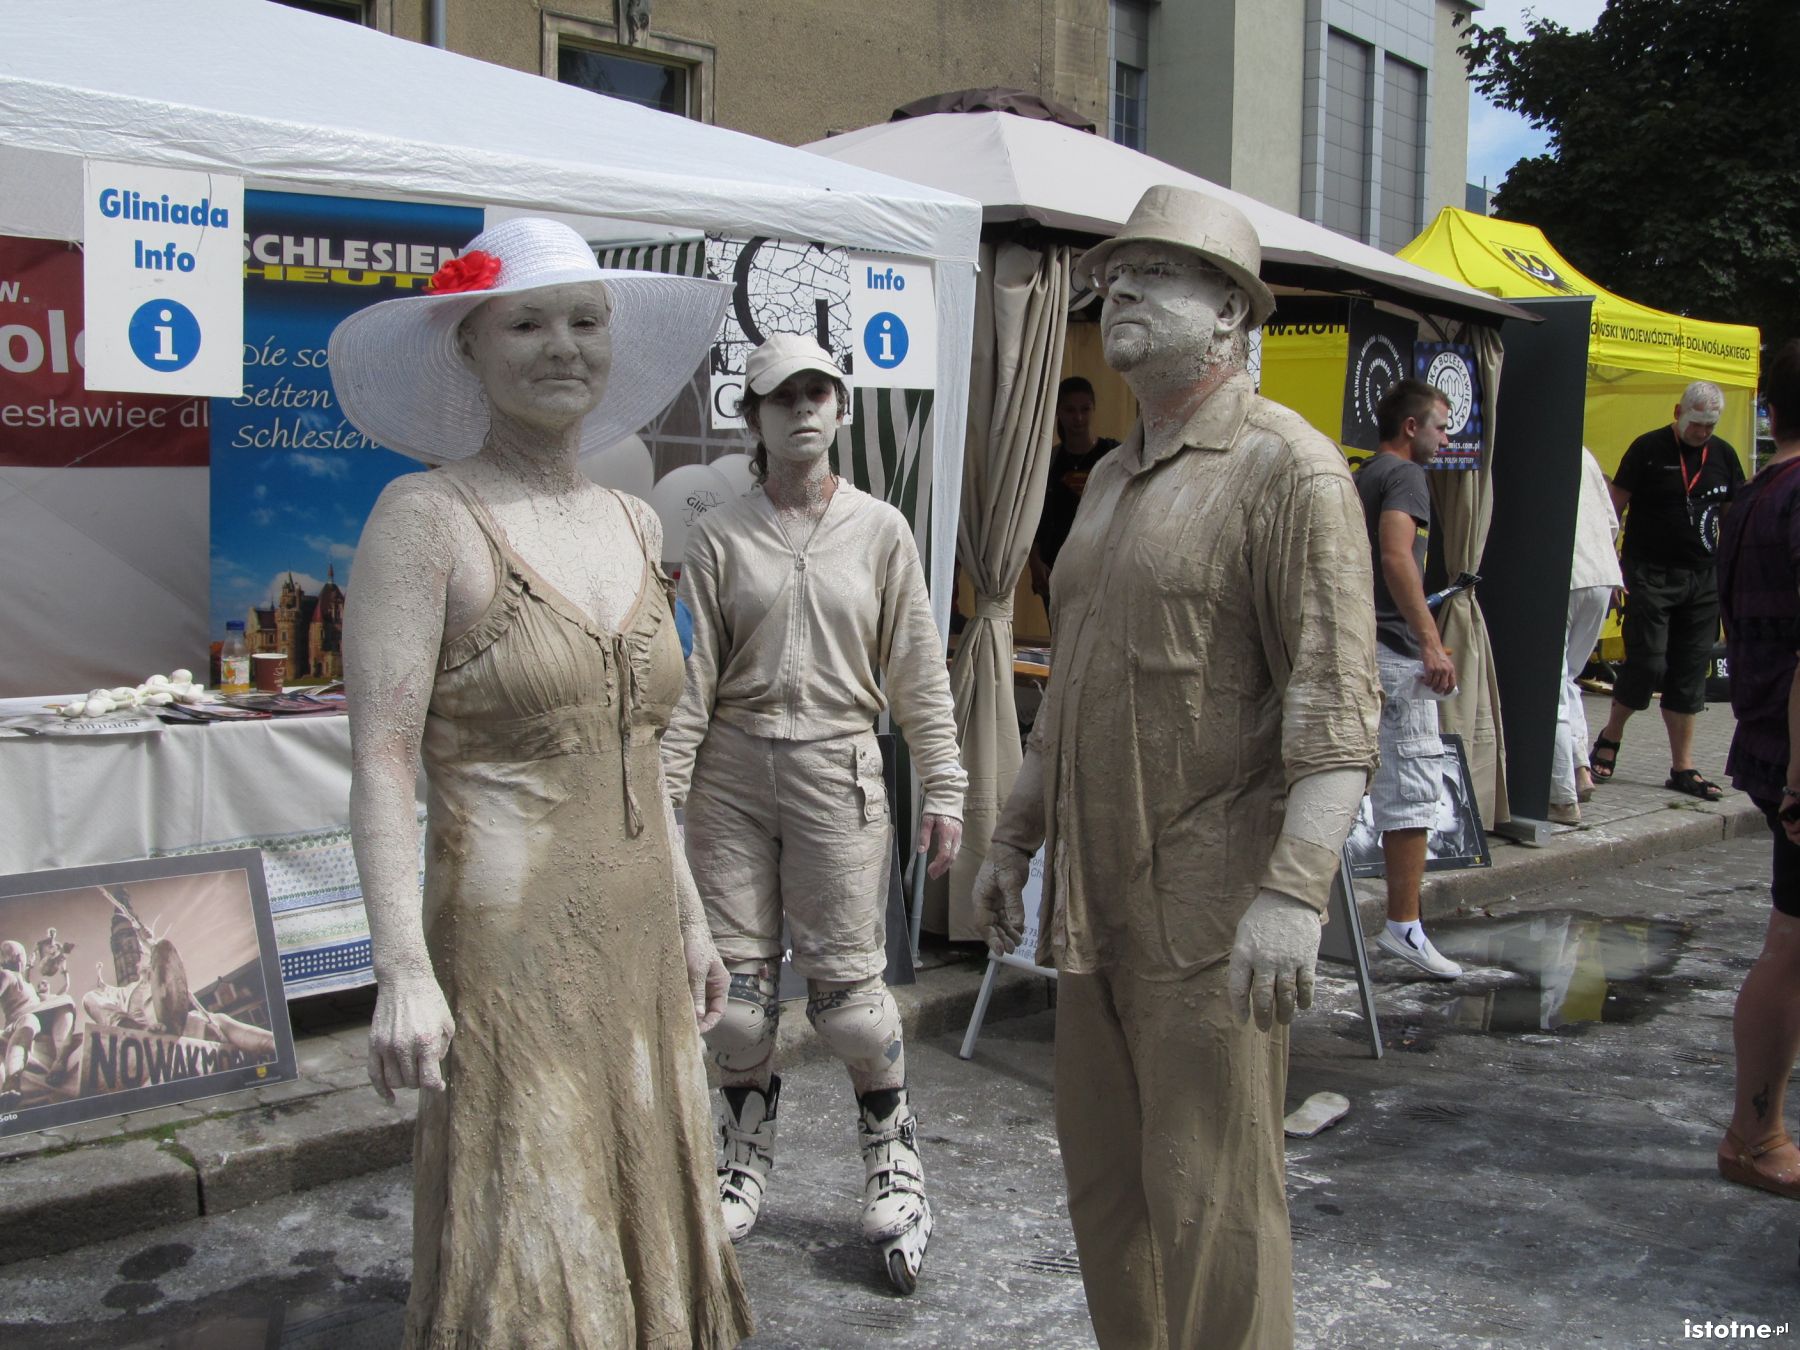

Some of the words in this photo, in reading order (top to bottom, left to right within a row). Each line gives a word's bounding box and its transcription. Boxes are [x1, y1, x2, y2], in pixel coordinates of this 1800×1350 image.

[100, 188, 229, 229] Gliniada
[134, 239, 196, 273] Info
[867, 266, 905, 292] Info
[1619, 327, 1685, 348] WOJEWÓDZTWA
[1686, 337, 1750, 360] DOLNOŚLĄSKIEGO
[231, 376, 333, 408] Seiten
